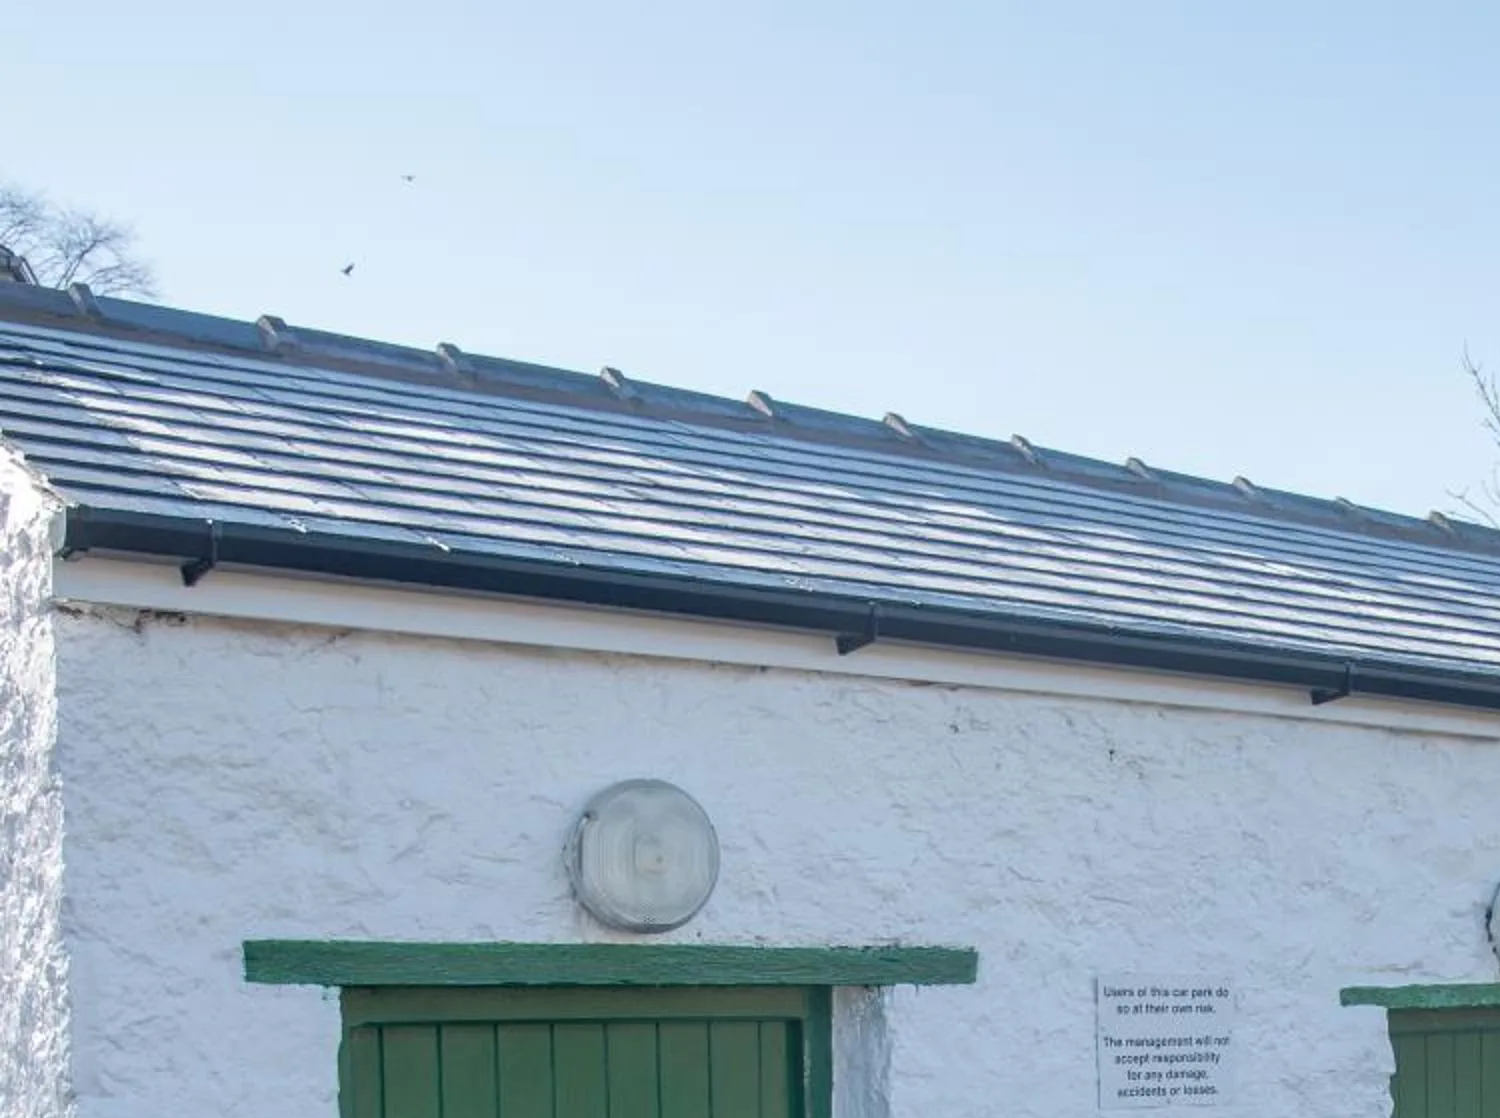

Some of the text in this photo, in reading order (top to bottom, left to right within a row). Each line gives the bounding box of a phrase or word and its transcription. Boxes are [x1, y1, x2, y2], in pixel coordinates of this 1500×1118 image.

[1138, 986, 1147, 998] of
[1151, 985, 1169, 998] this
[1172, 988, 1189, 997] car
[1191, 986, 1213, 1000] park
[1216, 986, 1229, 998] do
[1117, 1004, 1130, 1014] so
[1132, 1003, 1143, 1014] at
[1145, 1002, 1169, 1014] their
[1171, 1004, 1193, 1014] own
[1103, 1036, 1123, 1048] The
[1125, 1037, 1193, 1049] management
[1195, 1035, 1211, 1046] will
[1115, 1051, 1220, 1066] accept responsibility
[1127, 1069, 1143, 1081] for
[1144, 1072, 1163, 1083] any
[1117, 1086, 1167, 1097] accidents
[1169, 1087, 1181, 1097] or
